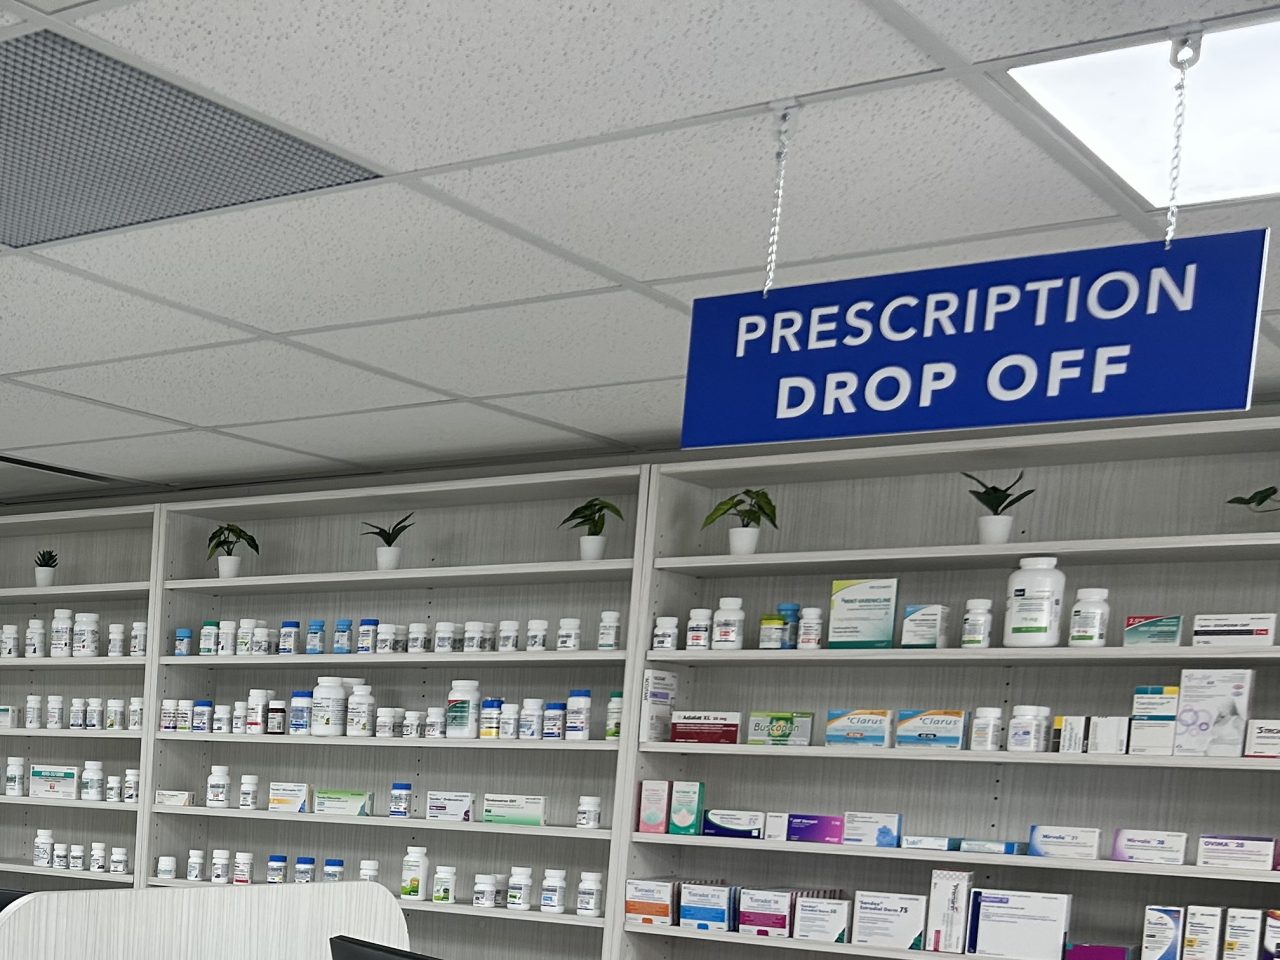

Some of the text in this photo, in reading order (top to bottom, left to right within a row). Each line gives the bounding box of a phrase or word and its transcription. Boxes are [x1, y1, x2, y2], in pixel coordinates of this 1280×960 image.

[735, 263, 1198, 358] PRESCRIPTION
[776, 344, 1132, 420] DROP OFF
[850, 716, 884, 725] Clarus
[922, 717, 959, 727] Clarus
[753, 721, 799, 733] Buscopan
